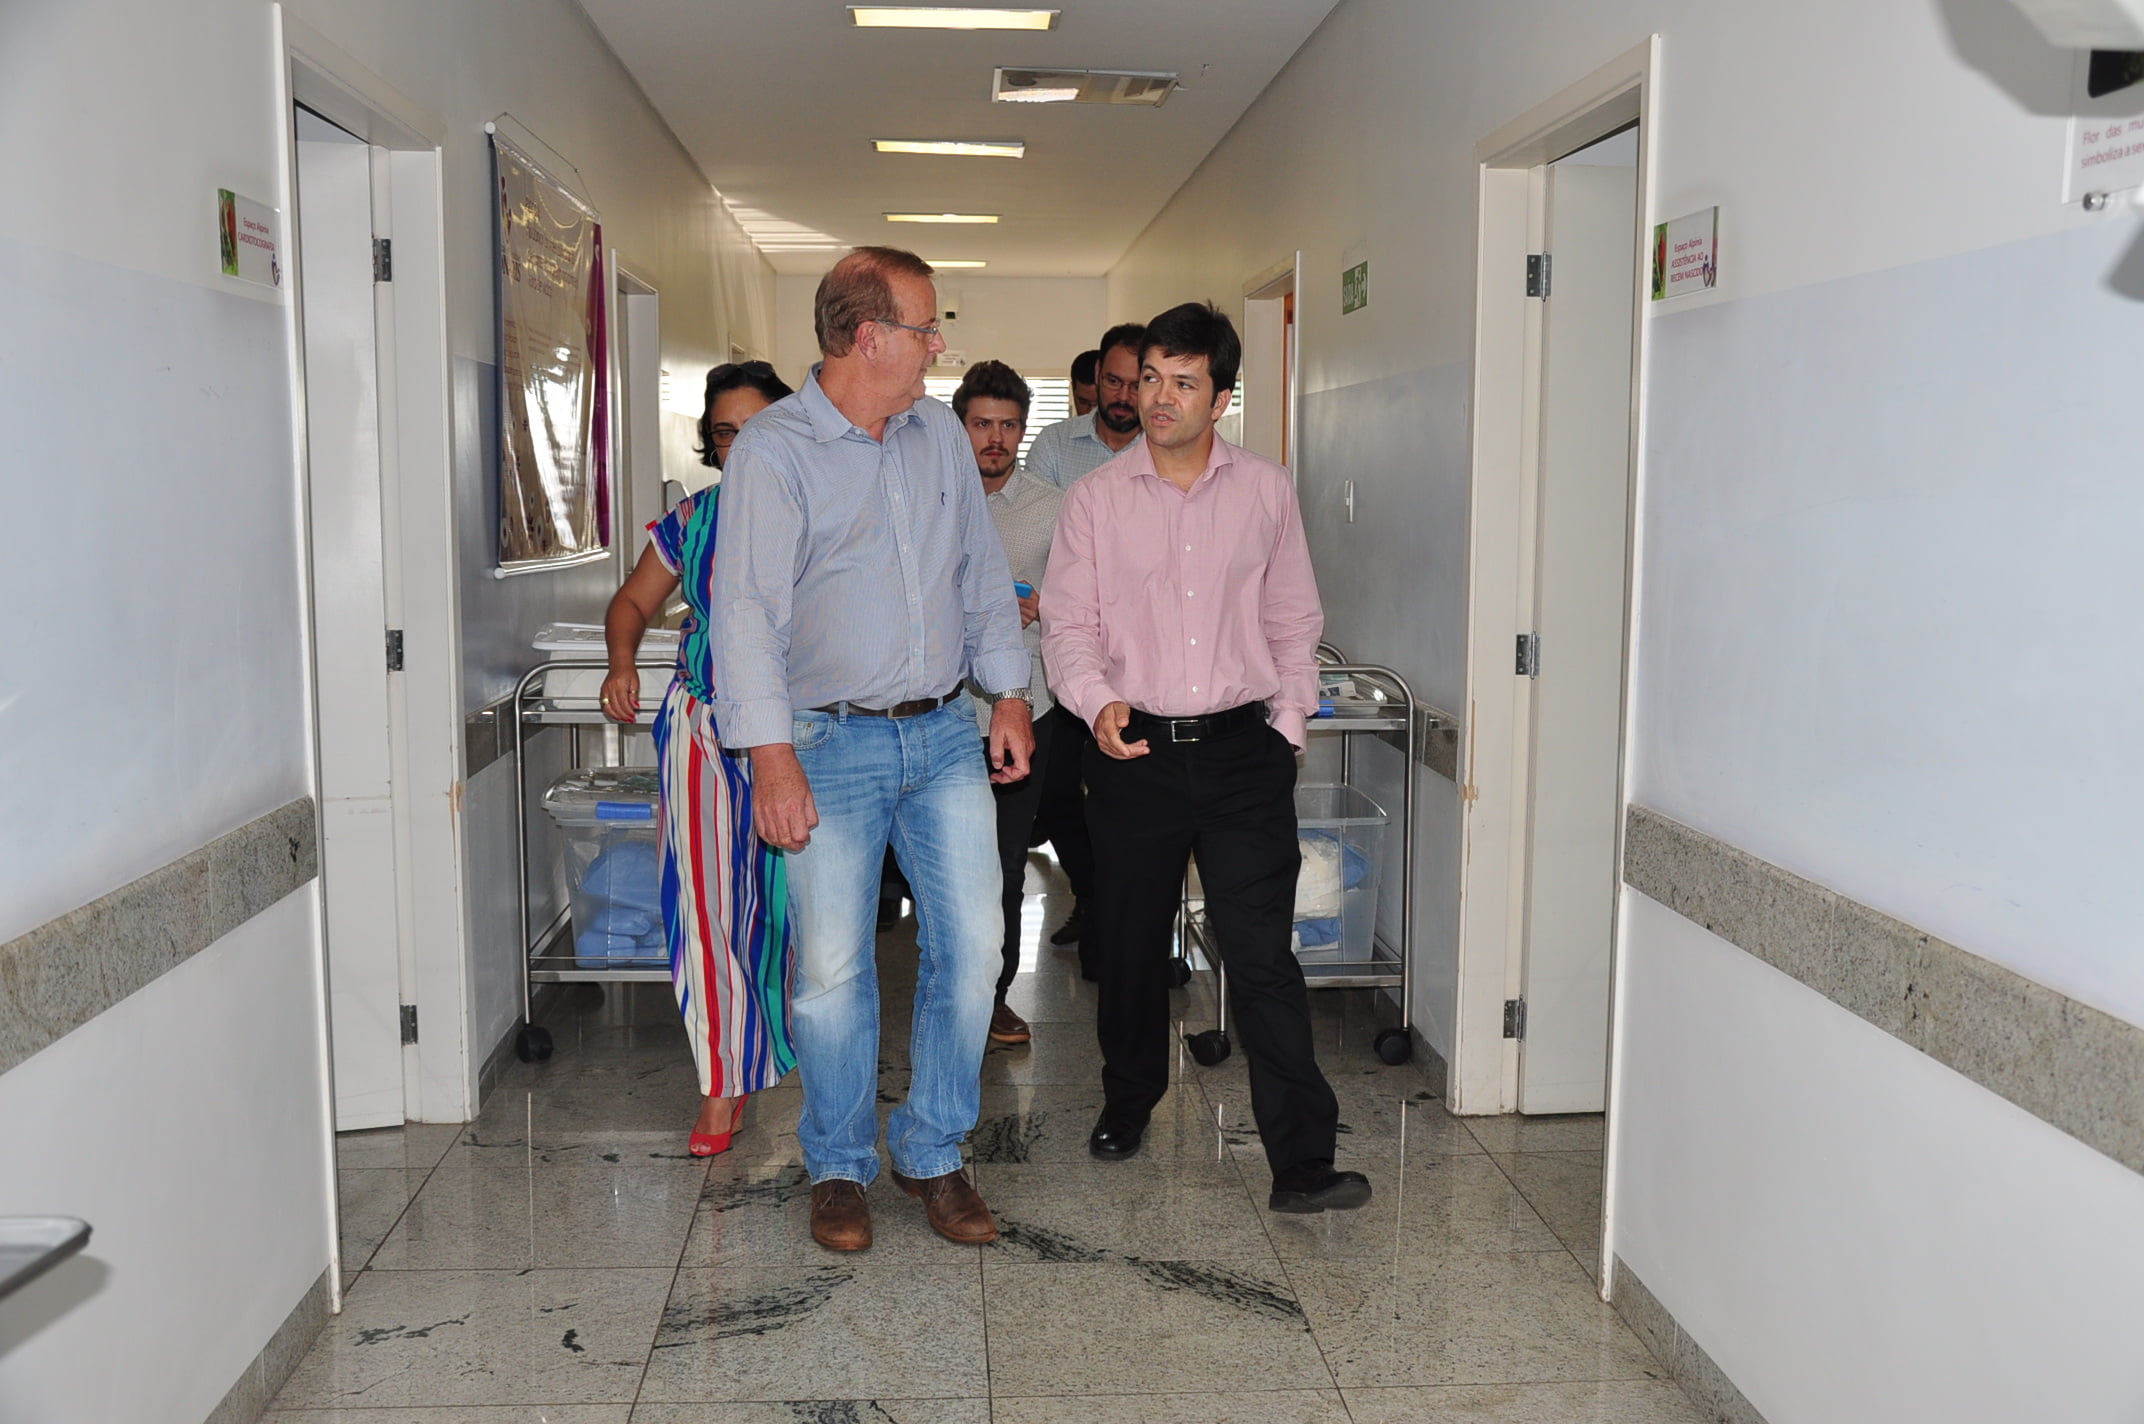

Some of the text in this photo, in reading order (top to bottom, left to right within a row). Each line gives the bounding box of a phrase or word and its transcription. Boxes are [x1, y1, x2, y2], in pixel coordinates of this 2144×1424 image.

[2105, 124, 2122, 139] das
[2081, 147, 2123, 168] simboliza
[1674, 239, 1702, 253] Espaço Alpina
